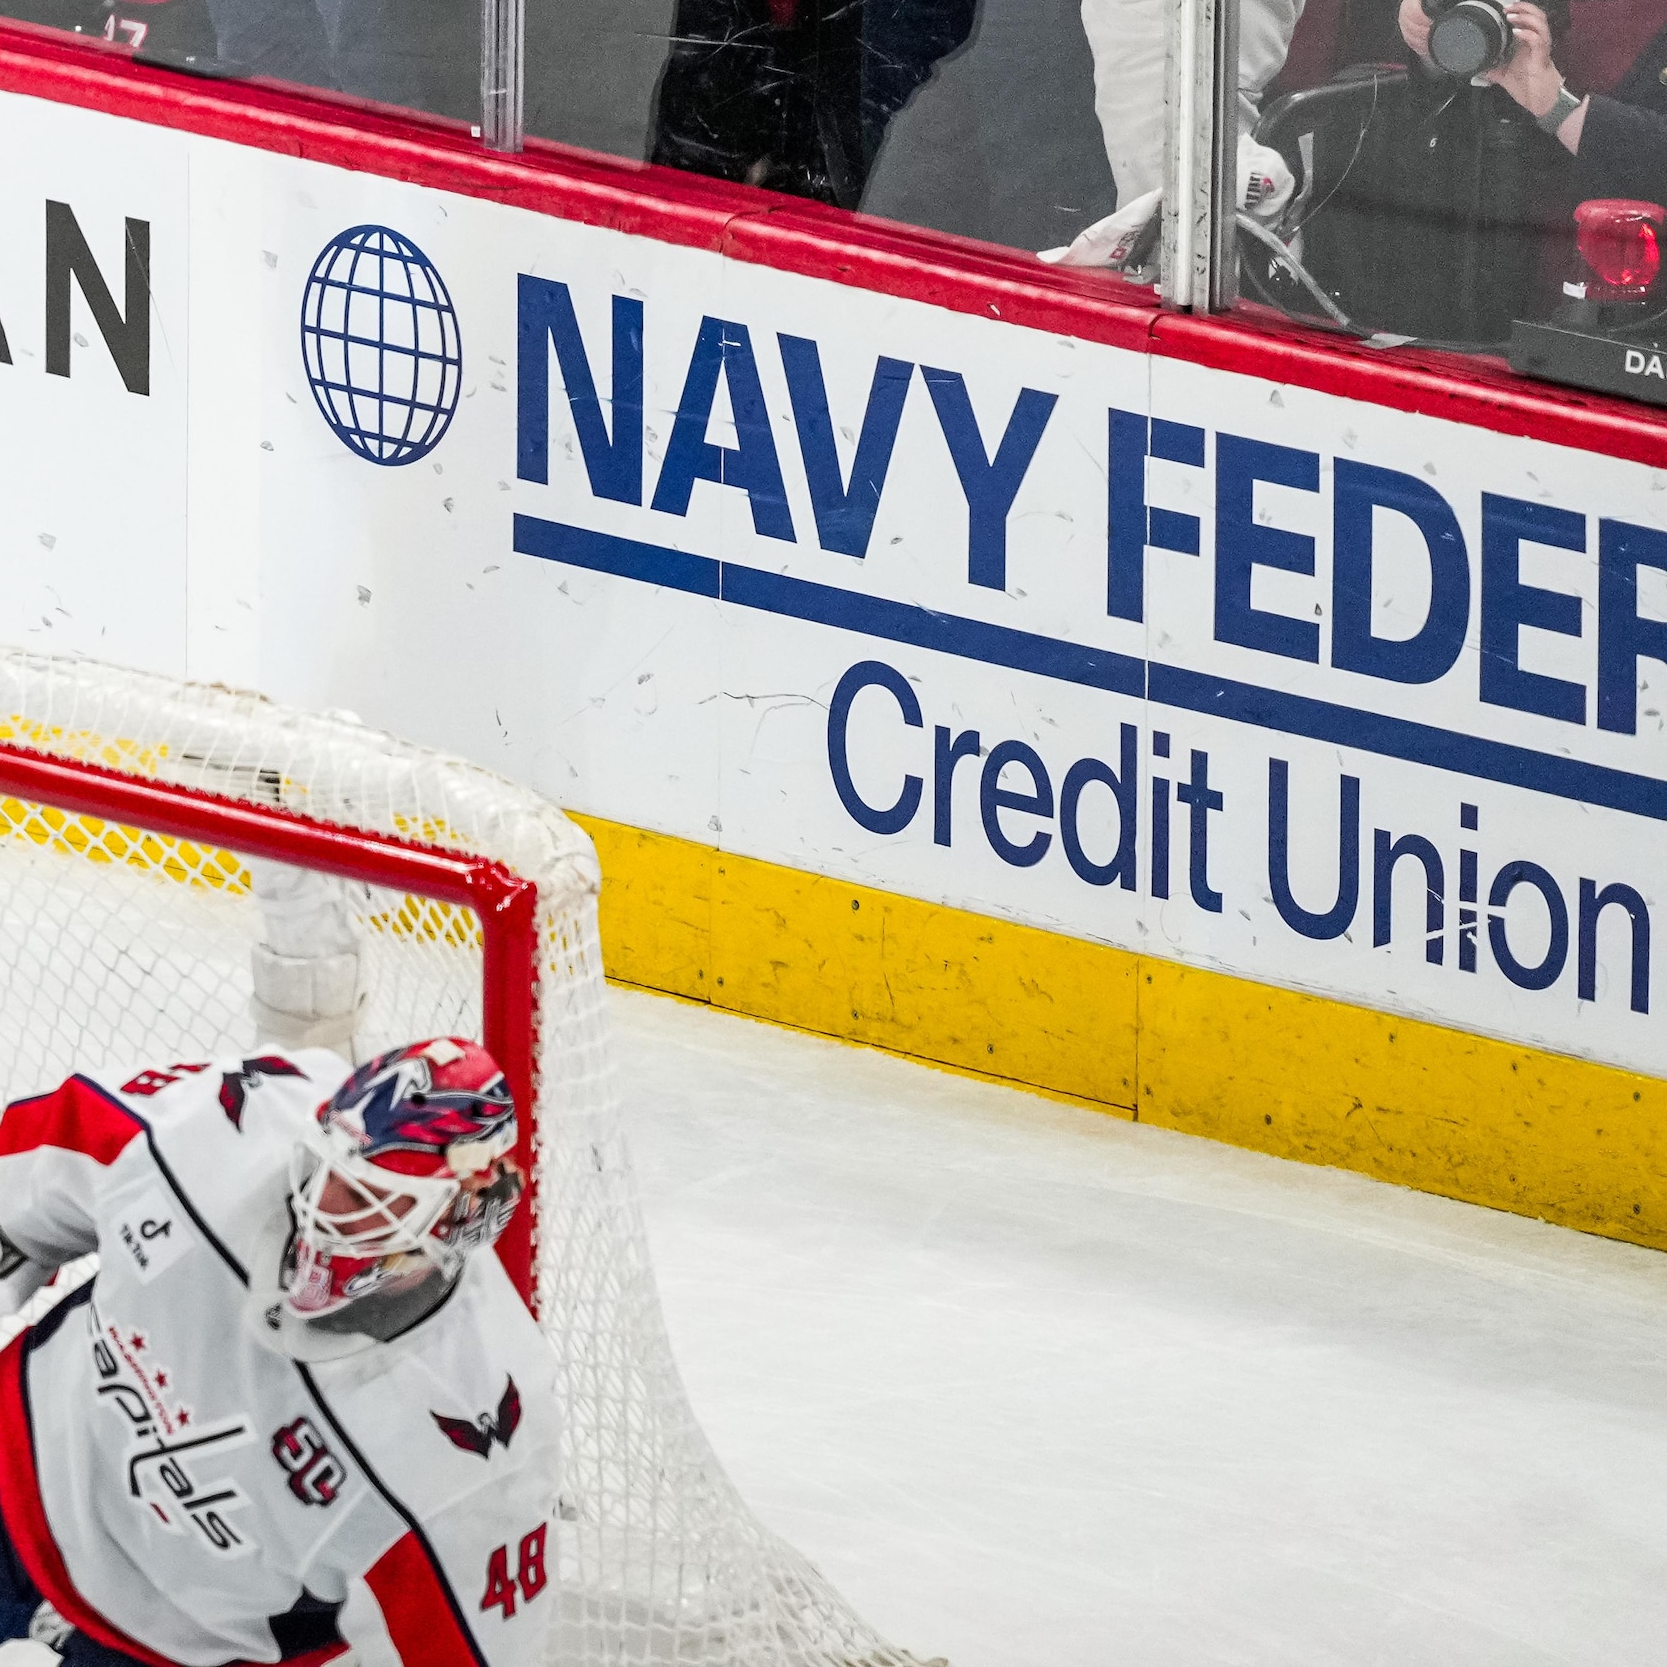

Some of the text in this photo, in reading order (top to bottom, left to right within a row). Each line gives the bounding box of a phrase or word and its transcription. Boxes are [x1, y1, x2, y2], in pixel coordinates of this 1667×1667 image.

[515, 273, 1059, 592] NAVY
[826, 658, 1651, 1018] Credit Union
[479, 1522, 549, 1619] 48
